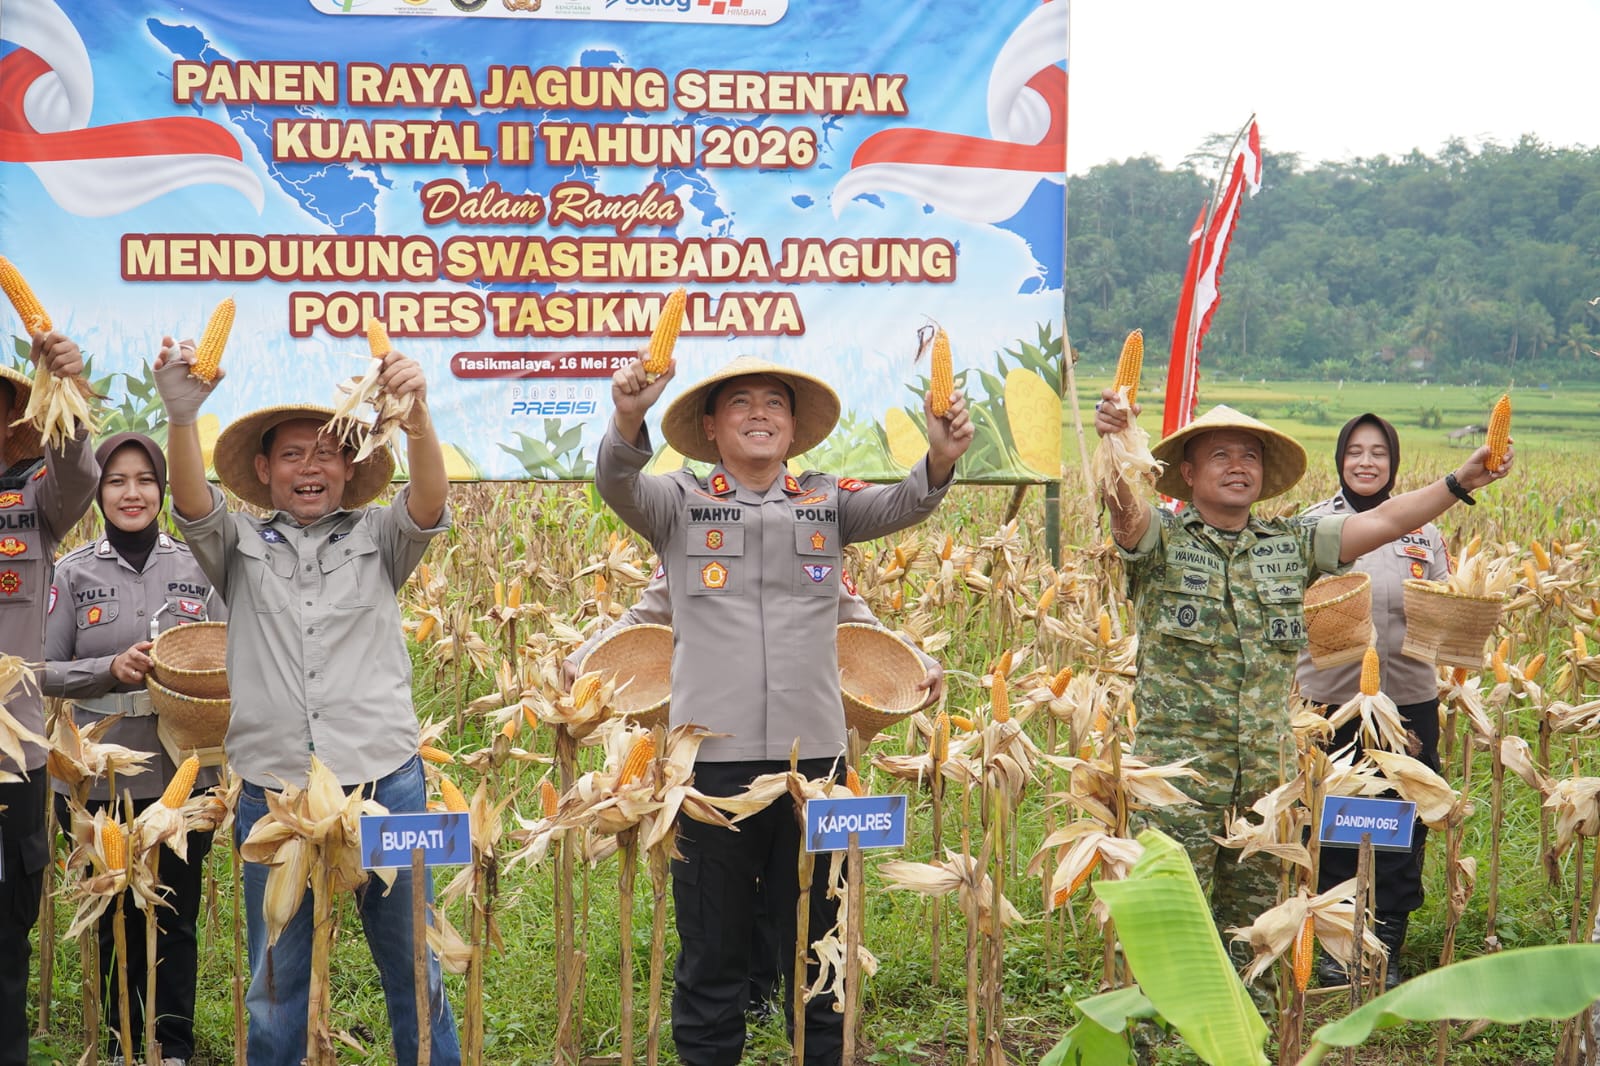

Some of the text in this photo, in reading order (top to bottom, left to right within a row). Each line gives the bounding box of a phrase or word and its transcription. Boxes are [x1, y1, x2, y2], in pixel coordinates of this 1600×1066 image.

[727, 8, 767, 17] HIMBARA
[177, 64, 905, 112] PANEN RAYA JAGUNG SERENTAK
[276, 122, 815, 165] KUARTAL II TAHUN 2026
[425, 184, 679, 232] Dalam Rangka
[126, 239, 951, 278] MENDUKUNG SWASEMBADA JAGUNG
[294, 296, 481, 333] POLRES
[459, 357, 555, 372] Tasikmalaya,
[560, 357, 577, 369] 16
[581, 357, 607, 369] Mei
[513, 387, 593, 400] POSKO
[511, 401, 597, 415] PRESISI
[690, 507, 741, 521] WAHYU
[796, 508, 836, 523] POLRI
[1175, 550, 1206, 565] WAWAN
[1257, 562, 1299, 575] TNI AD
[76, 587, 115, 603] YULI
[167, 582, 206, 597] POLRI
[818, 812, 892, 834] KAPOLRES
[1335, 814, 1399, 831] DANDIM 0612
[381, 829, 444, 851] BUPATI
